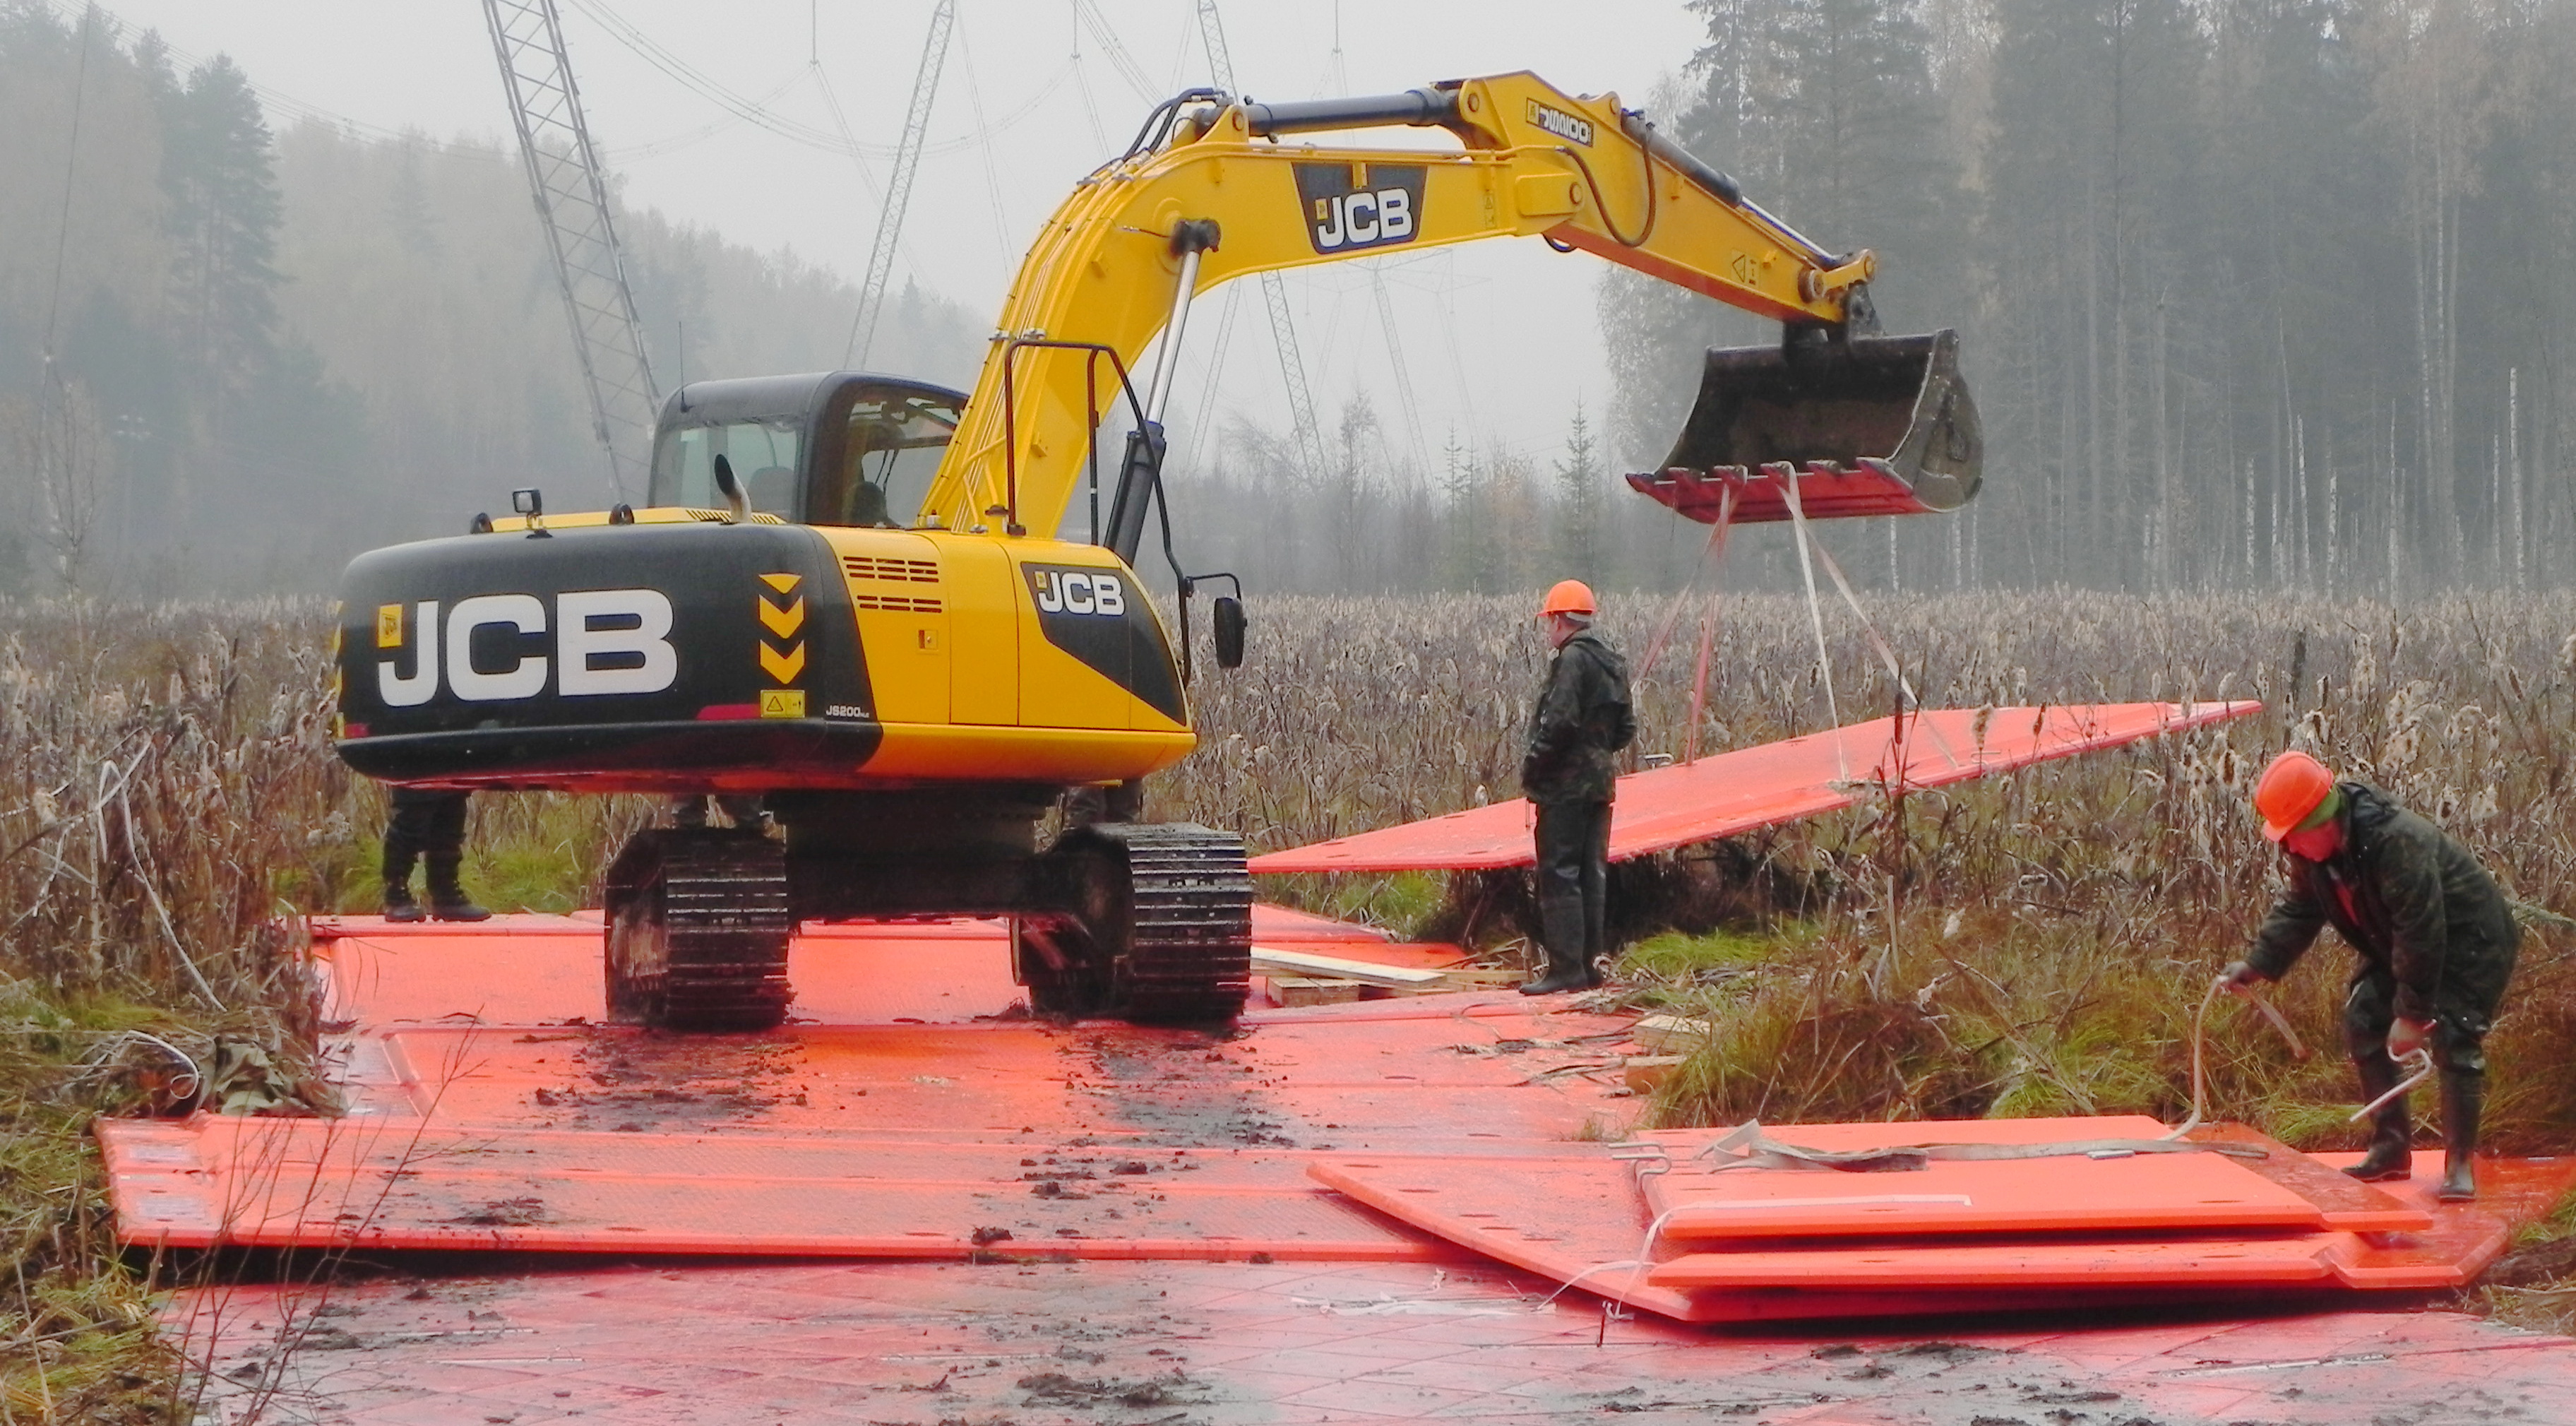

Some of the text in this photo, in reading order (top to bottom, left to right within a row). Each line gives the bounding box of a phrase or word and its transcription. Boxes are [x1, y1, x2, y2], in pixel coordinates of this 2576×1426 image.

[1317, 188, 1412, 247] JCB
[1037, 571, 1125, 616] JCB
[378, 588, 678, 707] JCB
